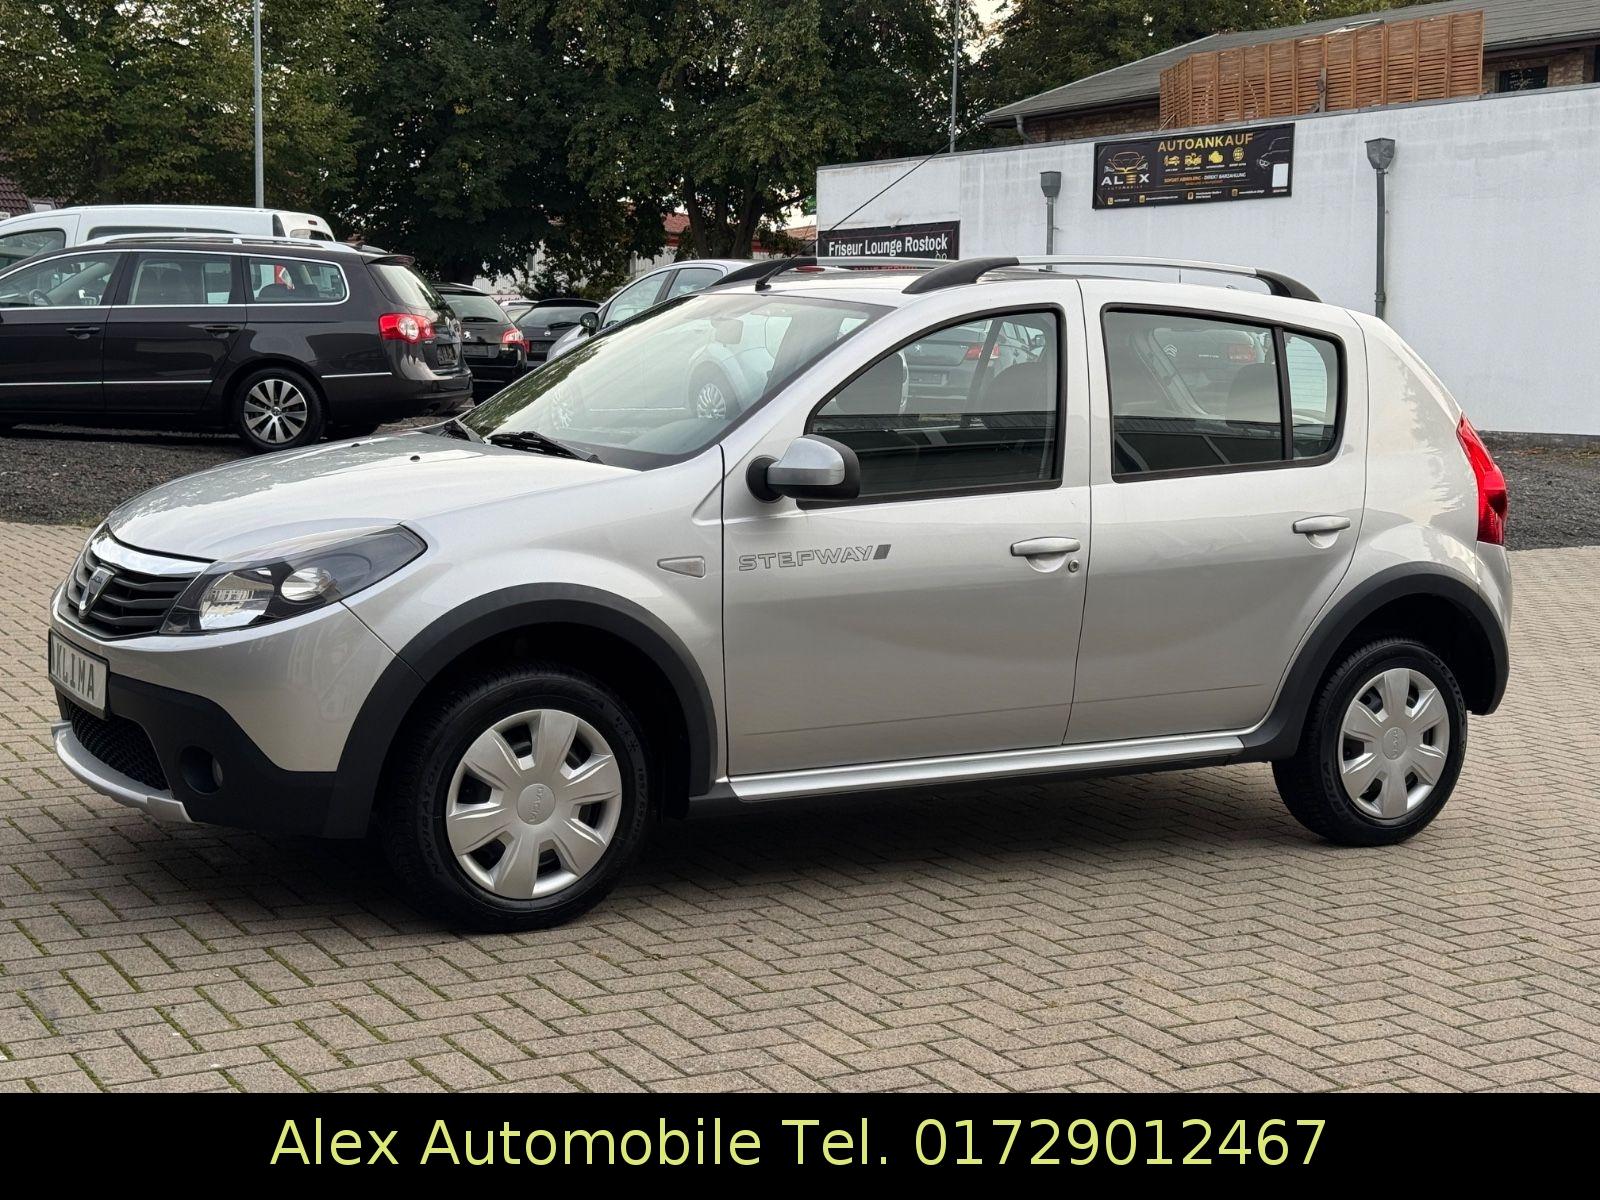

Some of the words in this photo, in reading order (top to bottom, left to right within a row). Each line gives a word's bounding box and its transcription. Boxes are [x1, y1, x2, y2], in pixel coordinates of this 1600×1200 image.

[1157, 132, 1254, 152] AUTOANKAUF
[1101, 172, 1150, 186] ALEX
[828, 240, 863, 256] Friseur
[865, 238, 902, 256] Lounge
[904, 233, 948, 252] Rostock
[738, 545, 873, 572] STEPWAY
